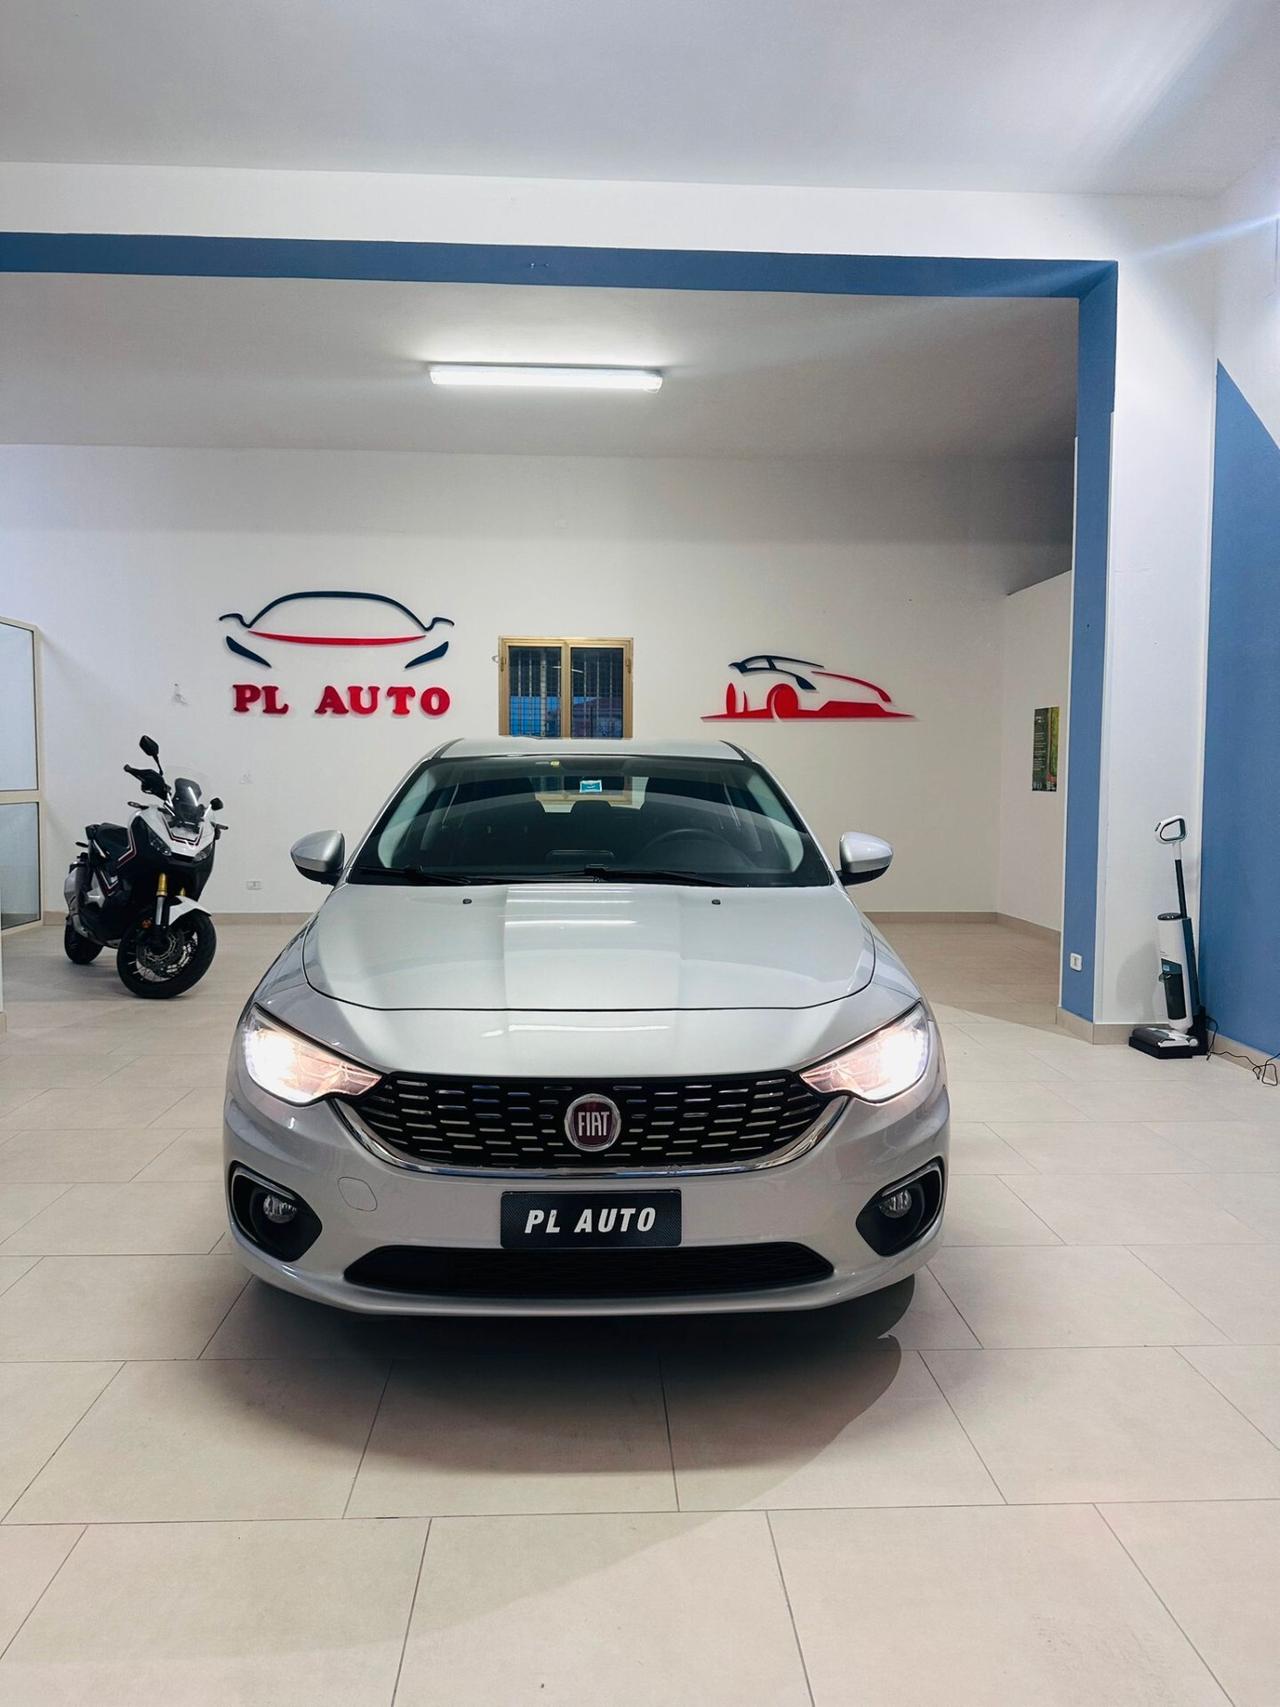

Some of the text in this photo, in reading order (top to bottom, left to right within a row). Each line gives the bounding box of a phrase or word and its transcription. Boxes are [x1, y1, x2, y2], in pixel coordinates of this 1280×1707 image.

[232, 684, 451, 716] PL AUTO
[578, 1111, 610, 1137] FIAT
[524, 1207, 656, 1234] PL AUTO
